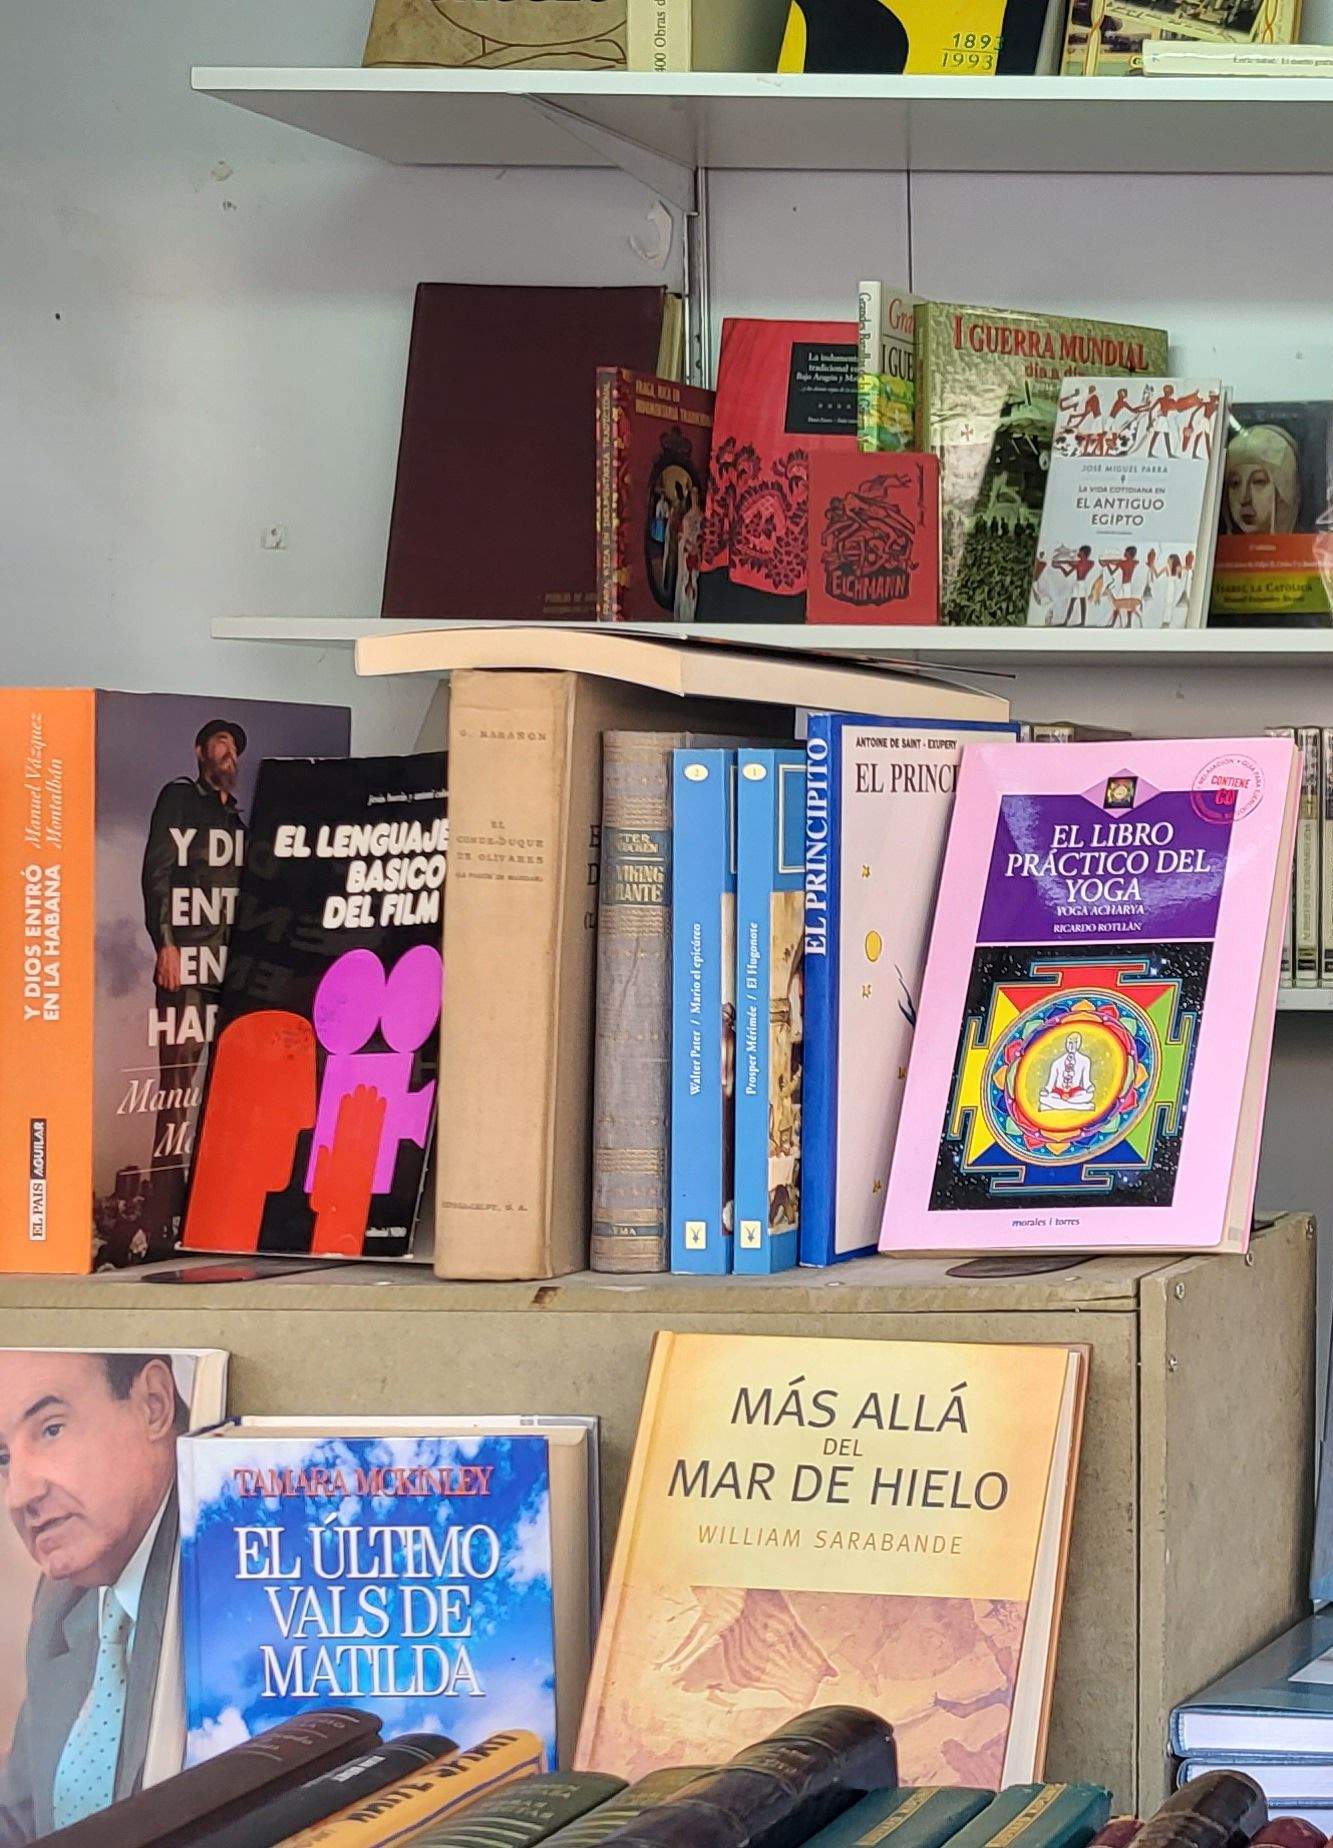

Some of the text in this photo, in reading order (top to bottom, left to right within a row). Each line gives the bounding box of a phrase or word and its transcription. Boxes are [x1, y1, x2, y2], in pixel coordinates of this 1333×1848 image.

[654, 11, 667, 47] Obras
[942, 52, 994, 71] 1993
[968, 323, 1149, 371] GUERRA MUNDIAL
[1105, 464, 1138, 474] MIGUEL
[1076, 497, 1165, 511] EL ANTIGUO
[1109, 485, 1154, 494] COTIDIANA
[1091, 513, 1144, 527] EGIPTO
[831, 575, 906, 600] EICHMANN
[855, 737, 957, 751] ANTOINE DE SAINT EXUPERY
[22, 711, 44, 850] Manuel Vázquez
[854, 762, 885, 793] EL
[1210, 775, 1252, 789] CONTIENE
[46, 756, 64, 850] Montalbán
[273, 817, 449, 859] EL LENGUAJE
[456, 835, 545, 849] CONDE-DUQUE
[491, 820, 507, 830] EL
[1050, 821, 1174, 849] EL LIBRO
[169, 828, 197, 868] Y
[456, 851, 545, 865] DE OLIVARES
[804, 736, 829, 957] EL PRINCIPITO
[1004, 845, 1212, 877] PRÁCTICO DEL
[346, 857, 447, 893] BASICO
[1063, 876, 1142, 903] YOGA
[322, 889, 440, 929] DEL FILM
[1056, 903, 1146, 917] YOGA ACHARYA
[21, 864, 43, 1021] Y DIOS ENTRÓ
[42, 864, 61, 1022] EN LA HABANA
[1053, 923, 1097, 934] RICARDO
[179, 946, 226, 986] EN
[689, 922, 705, 1095] Walter Pater Mario el epicúreo
[745, 922, 761, 1095] Prosper Mérimée Hugonote
[32, 1120, 46, 1178] AGUILAR
[32, 1217, 44, 1238] EL
[1011, 1216, 1080, 1228] morales torres
[730, 1375, 969, 1434] MÁS ALLÁ
[822, 1437, 864, 1458] DEL
[233, 1465, 346, 1499] TAMARA
[666, 1458, 1010, 1512] MAR DE HIELO
[234, 1511, 501, 1580] EL ÚLTIMO
[698, 1523, 964, 1557] WILLIAM SARABANDE
[263, 1584, 472, 1639] VALS DE
[259, 1645, 486, 1698] MATILDA
